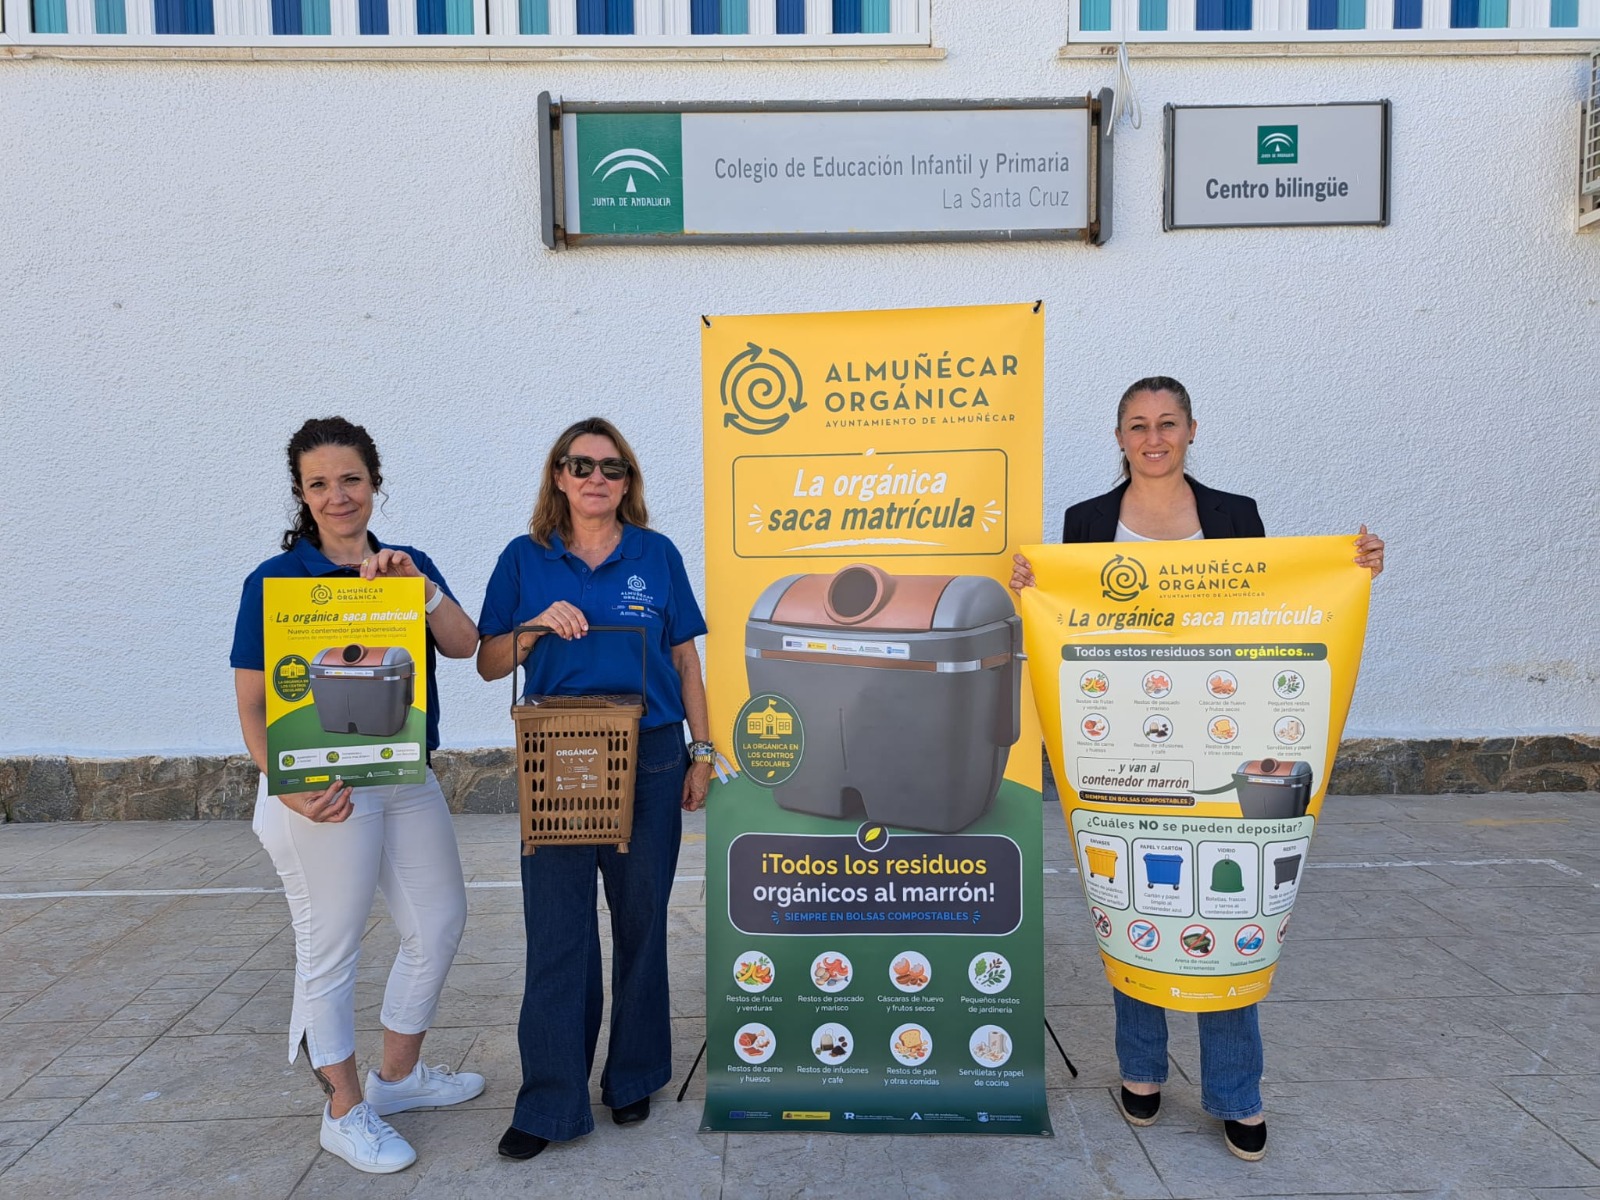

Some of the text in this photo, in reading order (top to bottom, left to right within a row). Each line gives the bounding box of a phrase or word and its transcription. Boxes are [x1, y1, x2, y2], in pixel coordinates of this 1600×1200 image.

[715, 152, 1070, 183] Colegio de Educación Infantil y Primaria
[1205, 177, 1349, 202] Centro bilingüe
[592, 197, 615, 207] JUNTA
[619, 197, 628, 207] DE
[943, 186, 1070, 209] La Santa Cruz
[825, 351, 1019, 383] ALMUÑÉCAR
[825, 383, 989, 413] ORGÁNICA
[825, 413, 1016, 428] AYUNTAMIENTO DE ALMUÑÉCAR
[793, 464, 947, 502] La orgánica
[768, 498, 975, 531] saca matrícula
[1159, 560, 1266, 575] ALMUÑÉCAR
[1159, 576, 1250, 591] ORGÁNICA
[337, 593, 377, 601] ORGÁNICA
[276, 608, 418, 624] La orgánica saca matrícula
[1069, 603, 1323, 630] La orgánica saca matrícula
[351, 627, 365, 635] para
[1074, 645, 1314, 660] Todos estos residuos son orgánicos...
[752, 742, 788, 750] ORGÁNICA
[789, 743, 799, 751] EN
[556, 748, 598, 757] ORGÁNICA
[751, 760, 791, 768] ESCOLARES
[1118, 763, 1126, 775] y
[1129, 763, 1147, 773] van
[1150, 762, 1161, 773] al
[1082, 775, 1189, 789] contenedor marrón
[1087, 816, 1302, 837] ¿Cuáles NO se pueden depositar?
[762, 853, 987, 875] ¡Todos los residuos
[753, 882, 995, 907] orgánicos al marrón!
[785, 911, 969, 921] SIEMPRE EN BOLSAS COMPOSTABLES
[751, 995, 760, 1003] de
[761, 995, 783, 1003] frutas
[833, 995, 865, 1003] pescado
[877, 994, 944, 1003] Cáscaras de huevo
[960, 996, 1020, 1005] Pequeños restos
[892, 1004, 913, 1012] frutos
[727, 1065, 751, 1073] Restos
[752, 1065, 762, 1073] de
[797, 1065, 821, 1073] Restos
[833, 1066, 869, 1074] infusiones
[886, 1067, 937, 1076] Restos de pan
[959, 1068, 996, 1076] Servilletas
[1003, 1069, 1024, 1078] papel
[745, 1075, 771, 1083] huesos
[828, 1075, 844, 1083] café
[985, 1079, 1009, 1087] cocina
